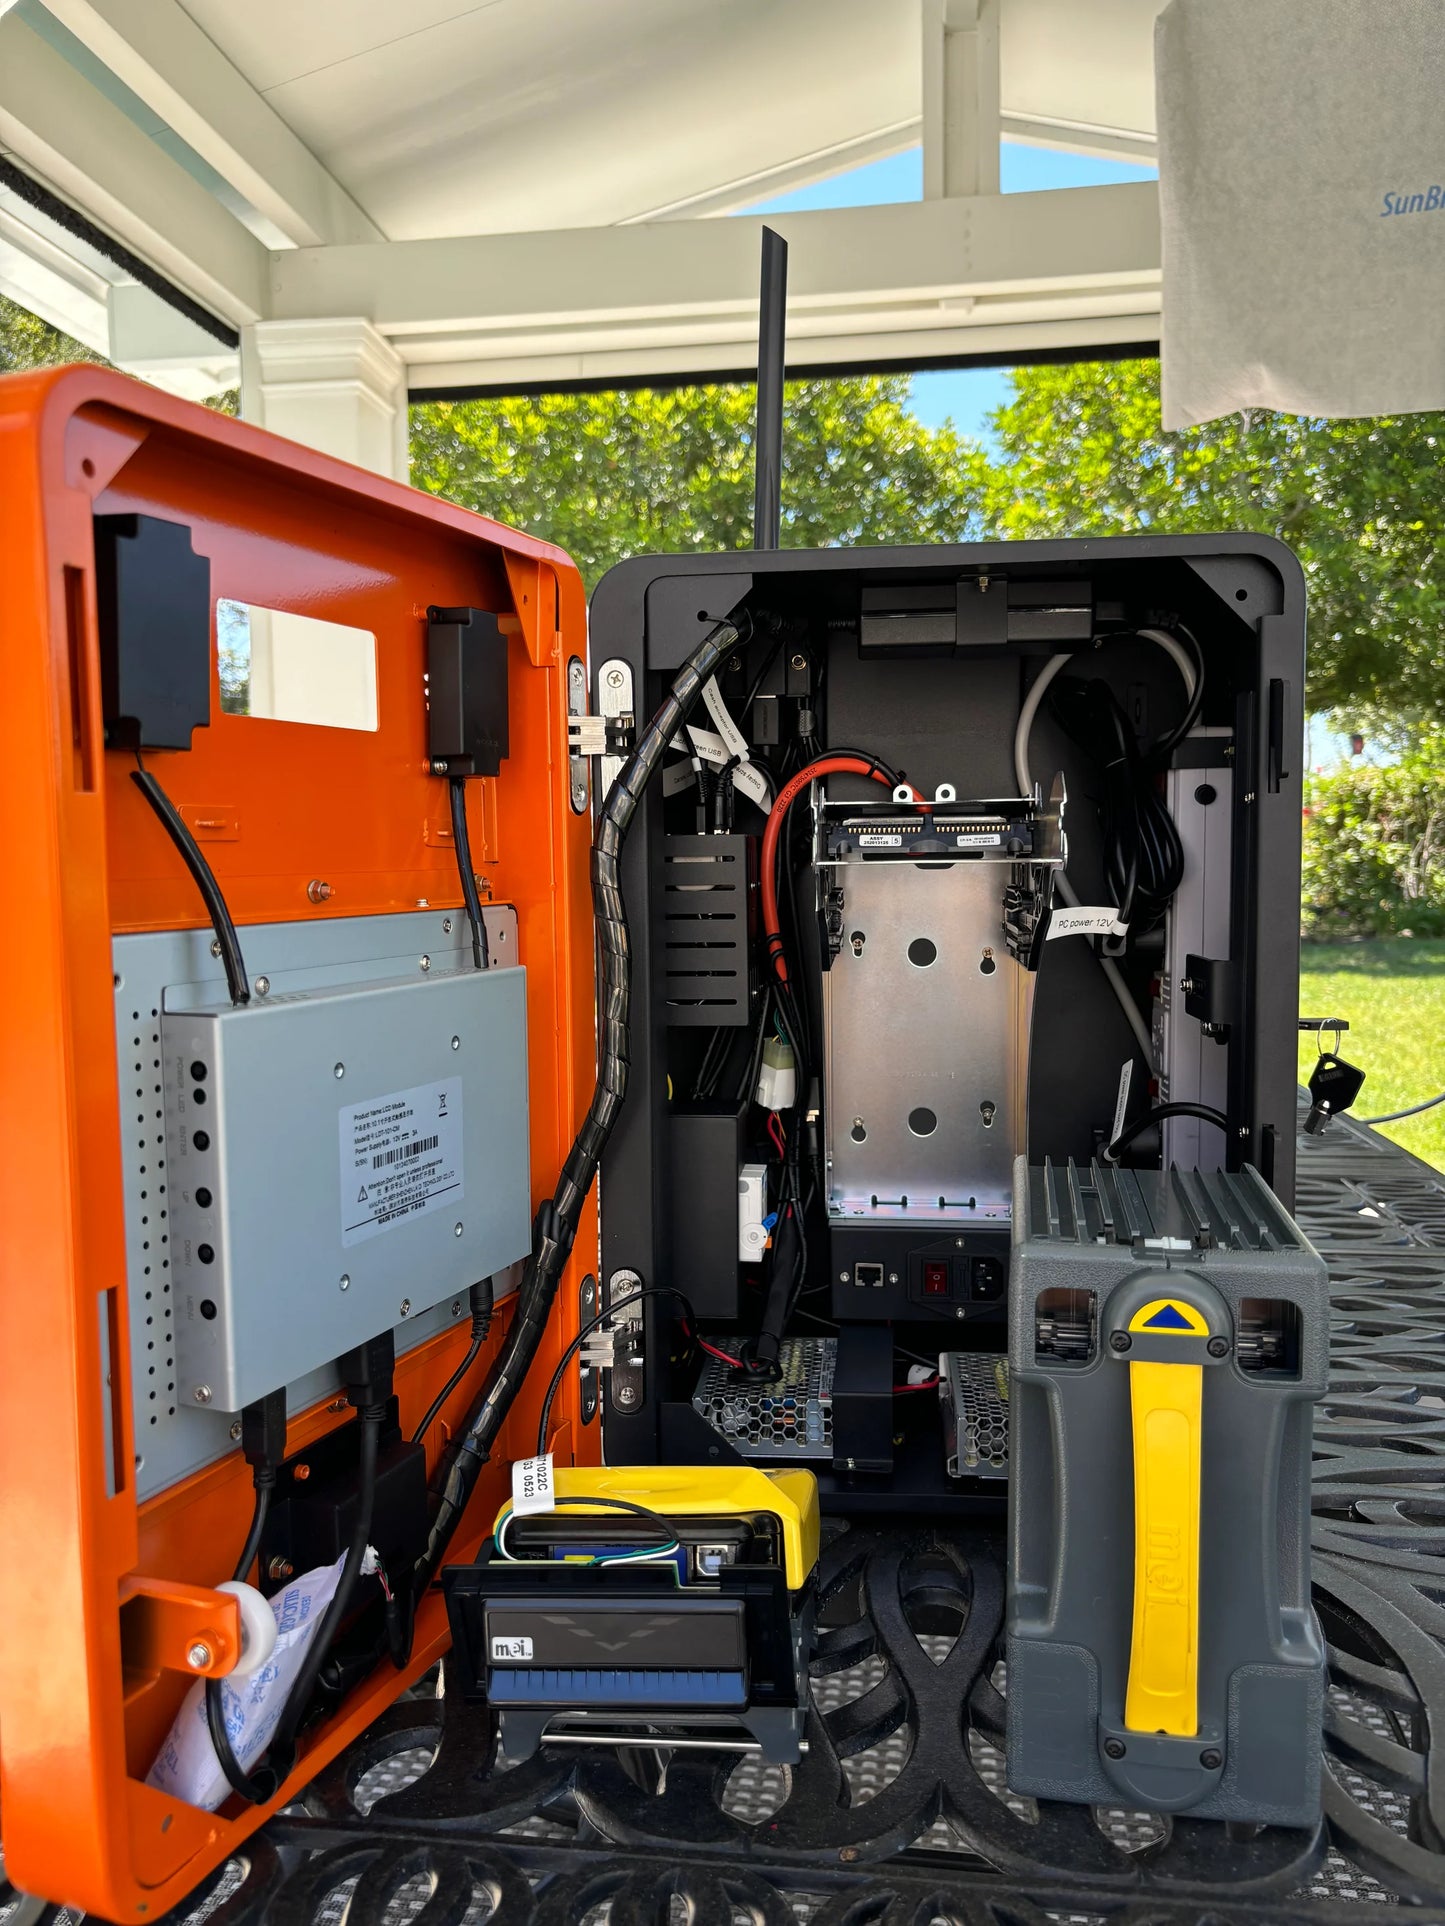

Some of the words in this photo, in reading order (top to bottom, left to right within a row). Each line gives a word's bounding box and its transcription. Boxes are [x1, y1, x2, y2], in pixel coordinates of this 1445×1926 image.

[708, 687, 716, 705] Cash
[714, 704, 730, 730] acceptor
[728, 729, 738, 744] USB
[708, 747, 722, 757] USB
[784, 790, 792, 799] G3
[1058, 919, 1068, 928] PC
[1070, 919, 1092, 928] power
[1096, 918, 1114, 927] 12V
[353, 1110, 369, 1121] Product
[392, 1100, 405, 1110] Module
[179, 1125, 188, 1156] ENTER
[355, 1145, 367, 1155] Power
[378, 1214, 390, 1225] MADE
[396, 1207, 408, 1217] CHINA
[184, 1240, 192, 1268] DOWN
[523, 1460, 533, 1470] G3
[524, 1475, 534, 1498] 0523
[496, 1639, 525, 1658] mei
